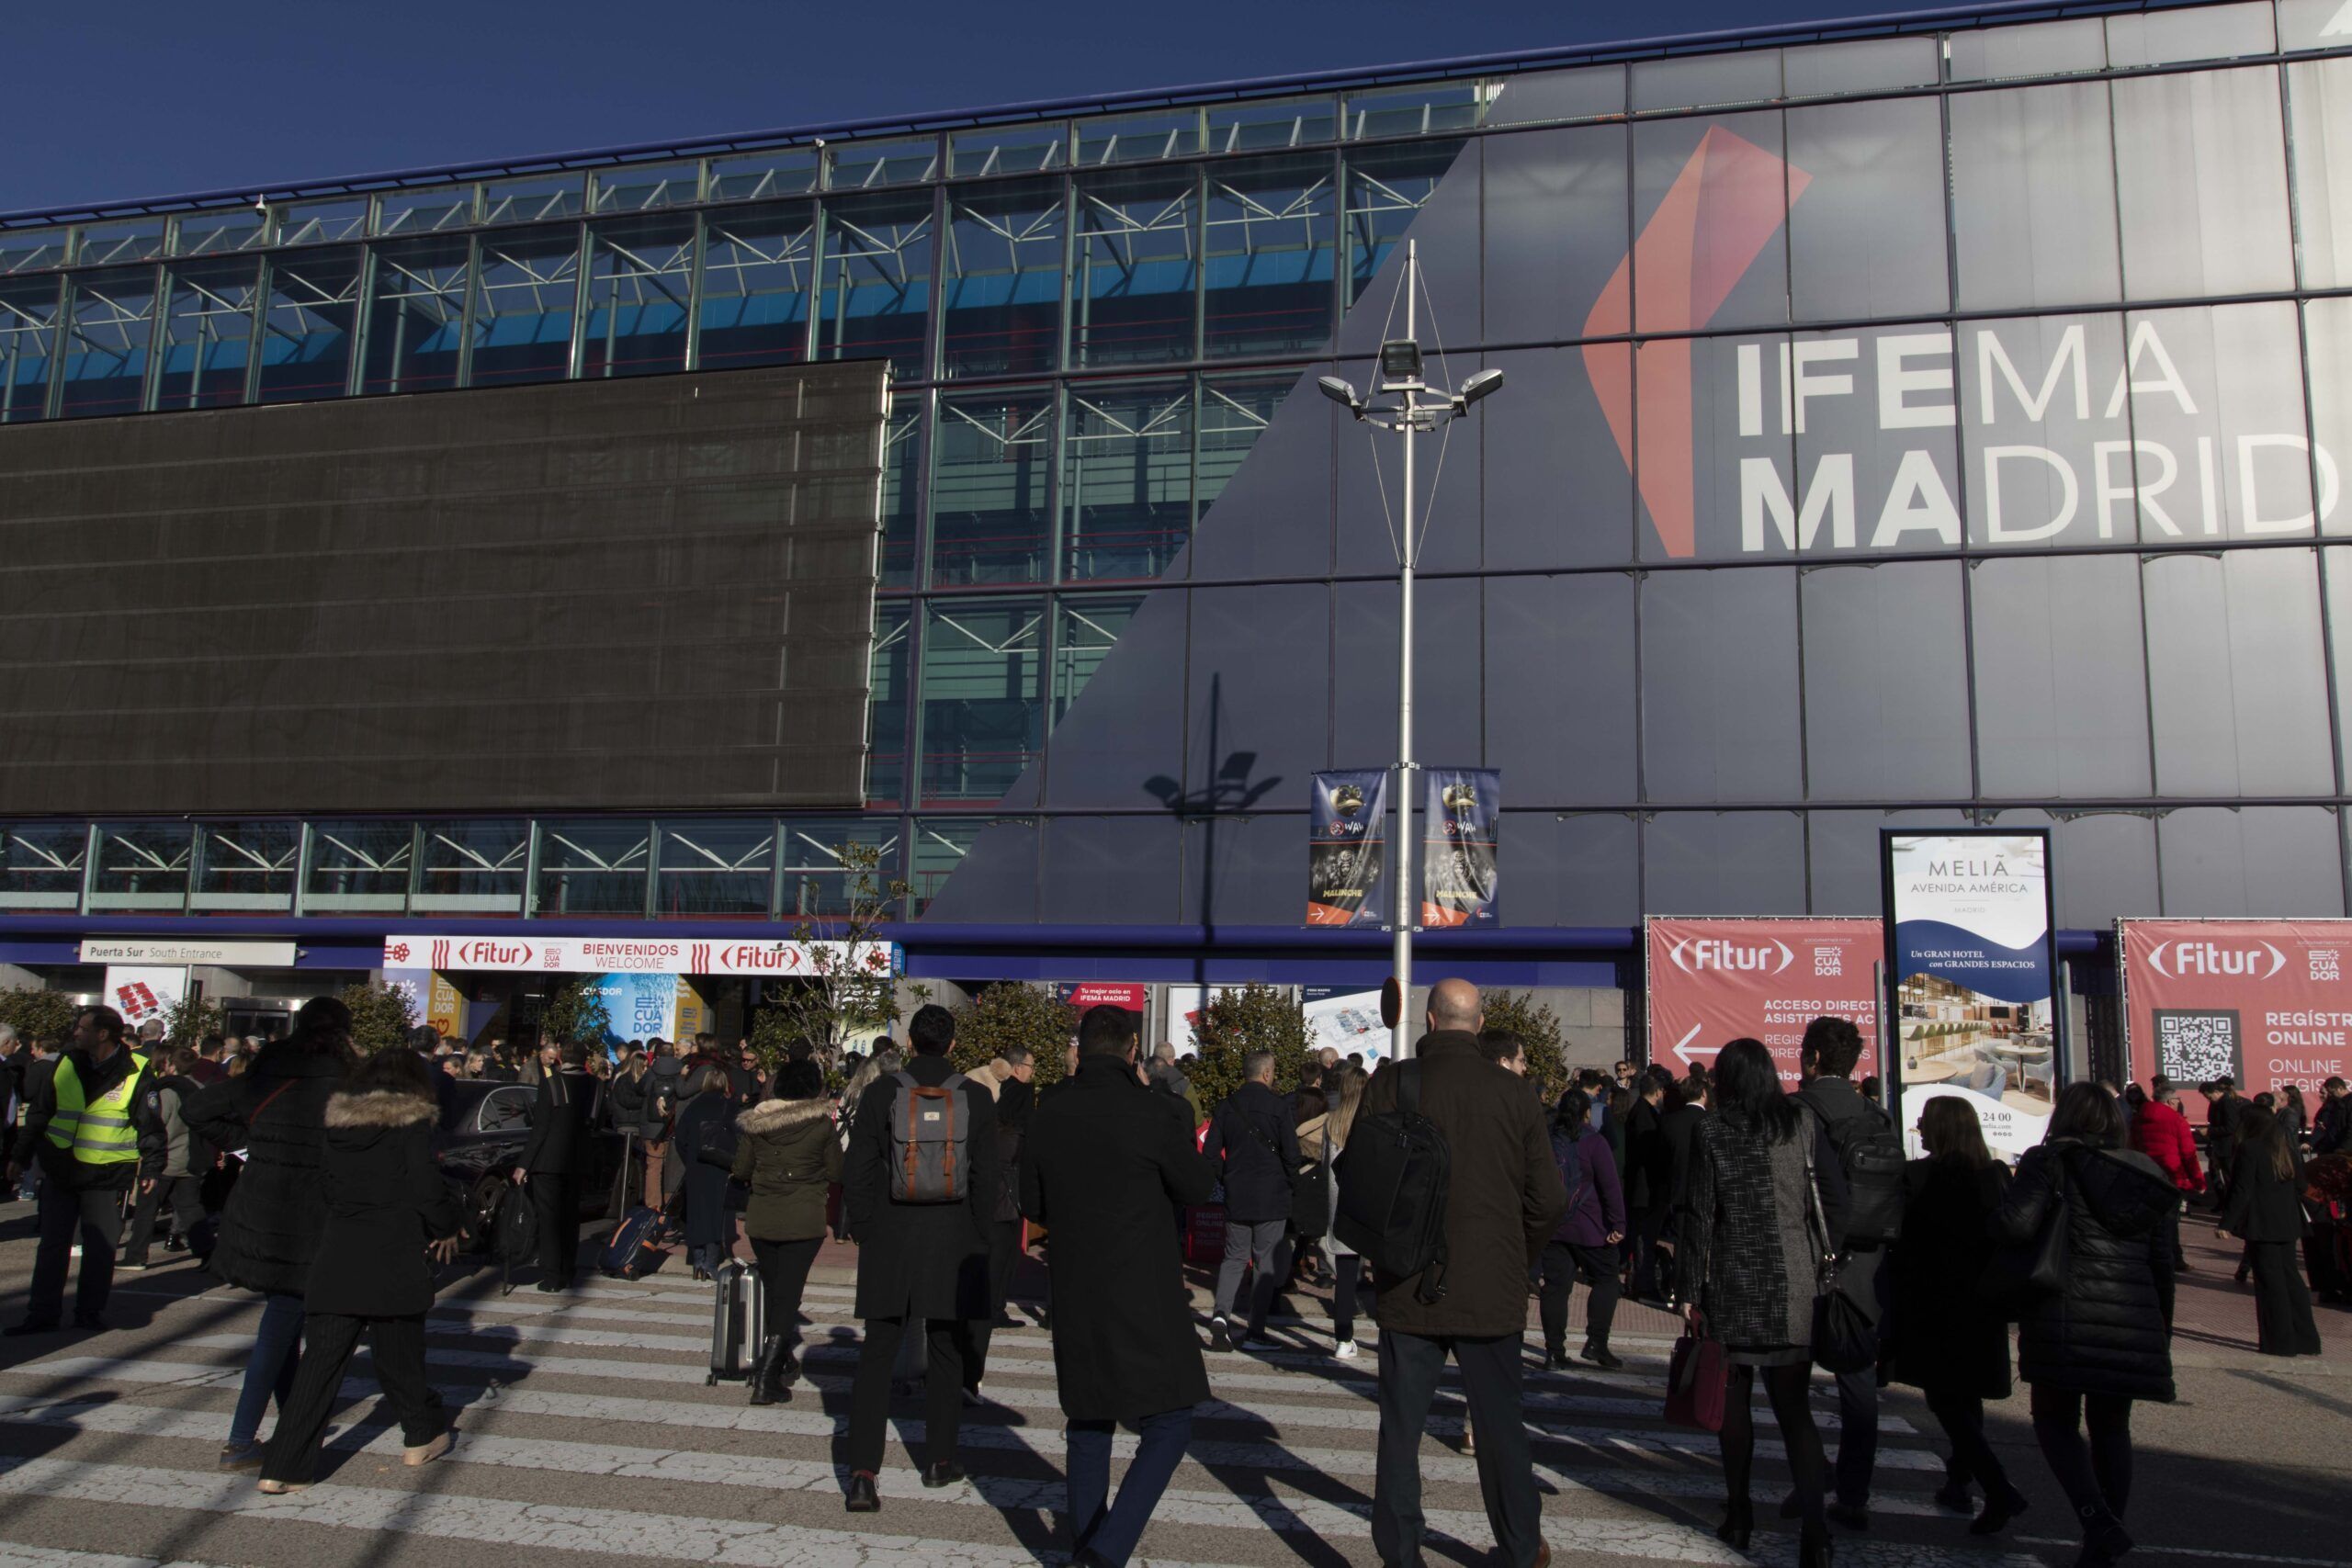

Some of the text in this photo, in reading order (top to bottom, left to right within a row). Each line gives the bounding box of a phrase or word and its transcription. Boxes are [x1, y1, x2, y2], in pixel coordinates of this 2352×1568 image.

[1736, 321, 2199, 436] IFEMA
[1740, 433, 2340, 551] MADRID
[1323, 888, 1363, 897] MALINCHE
[1436, 889, 1477, 899] MALINCHE
[1911, 881, 2029, 894] AVENIDA AMÉRICA
[90, 946, 222, 959] Puerta Sur South Entrance
[472, 942, 521, 964] Fitur
[582, 943, 679, 956] BIENVENIDOS
[1695, 940, 1772, 970] Fitur
[1911, 950, 1984, 958] Un GRAN HOTEL
[595, 956, 664, 969] WELCOME
[736, 946, 786, 968] Fitur
[2176, 942, 2262, 975] Fitur
[1944, 960, 1990, 968] GRANDES
[1991, 960, 2036, 969] ESPACIOS
[1764, 999, 1886, 1011] ACCESO DIRECT
[1764, 1013, 1851, 1024] ASISTES
[2267, 1031, 2346, 1045] ONLINE
[2268, 1058, 2343, 1074] ONLINE
[1983, 1112, 2011, 1122] 24 00
